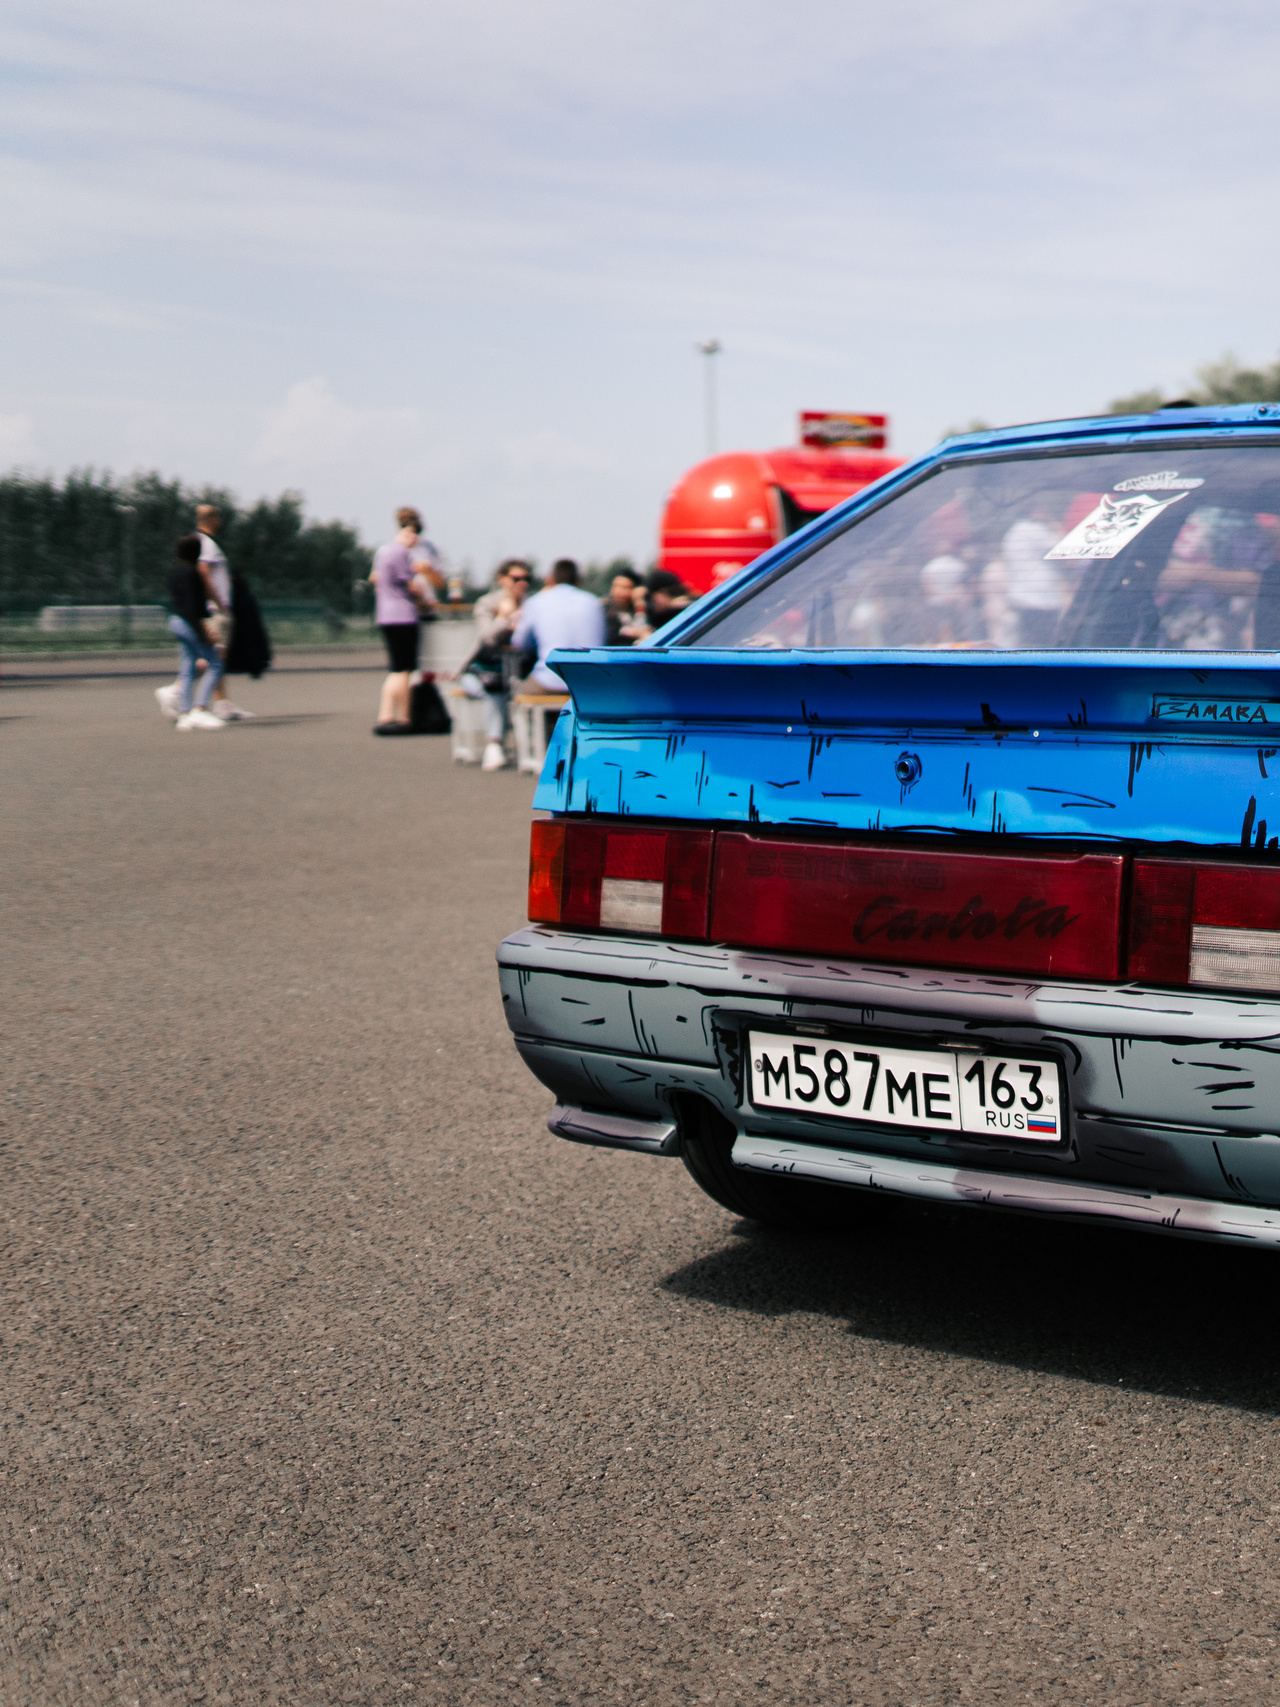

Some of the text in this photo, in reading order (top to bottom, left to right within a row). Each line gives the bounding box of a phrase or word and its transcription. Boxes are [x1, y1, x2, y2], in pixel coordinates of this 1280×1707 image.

[853, 895, 1081, 944] Carlota
[762, 1044, 1044, 1120] M587ME 163
[986, 1111, 1025, 1130] RUS
